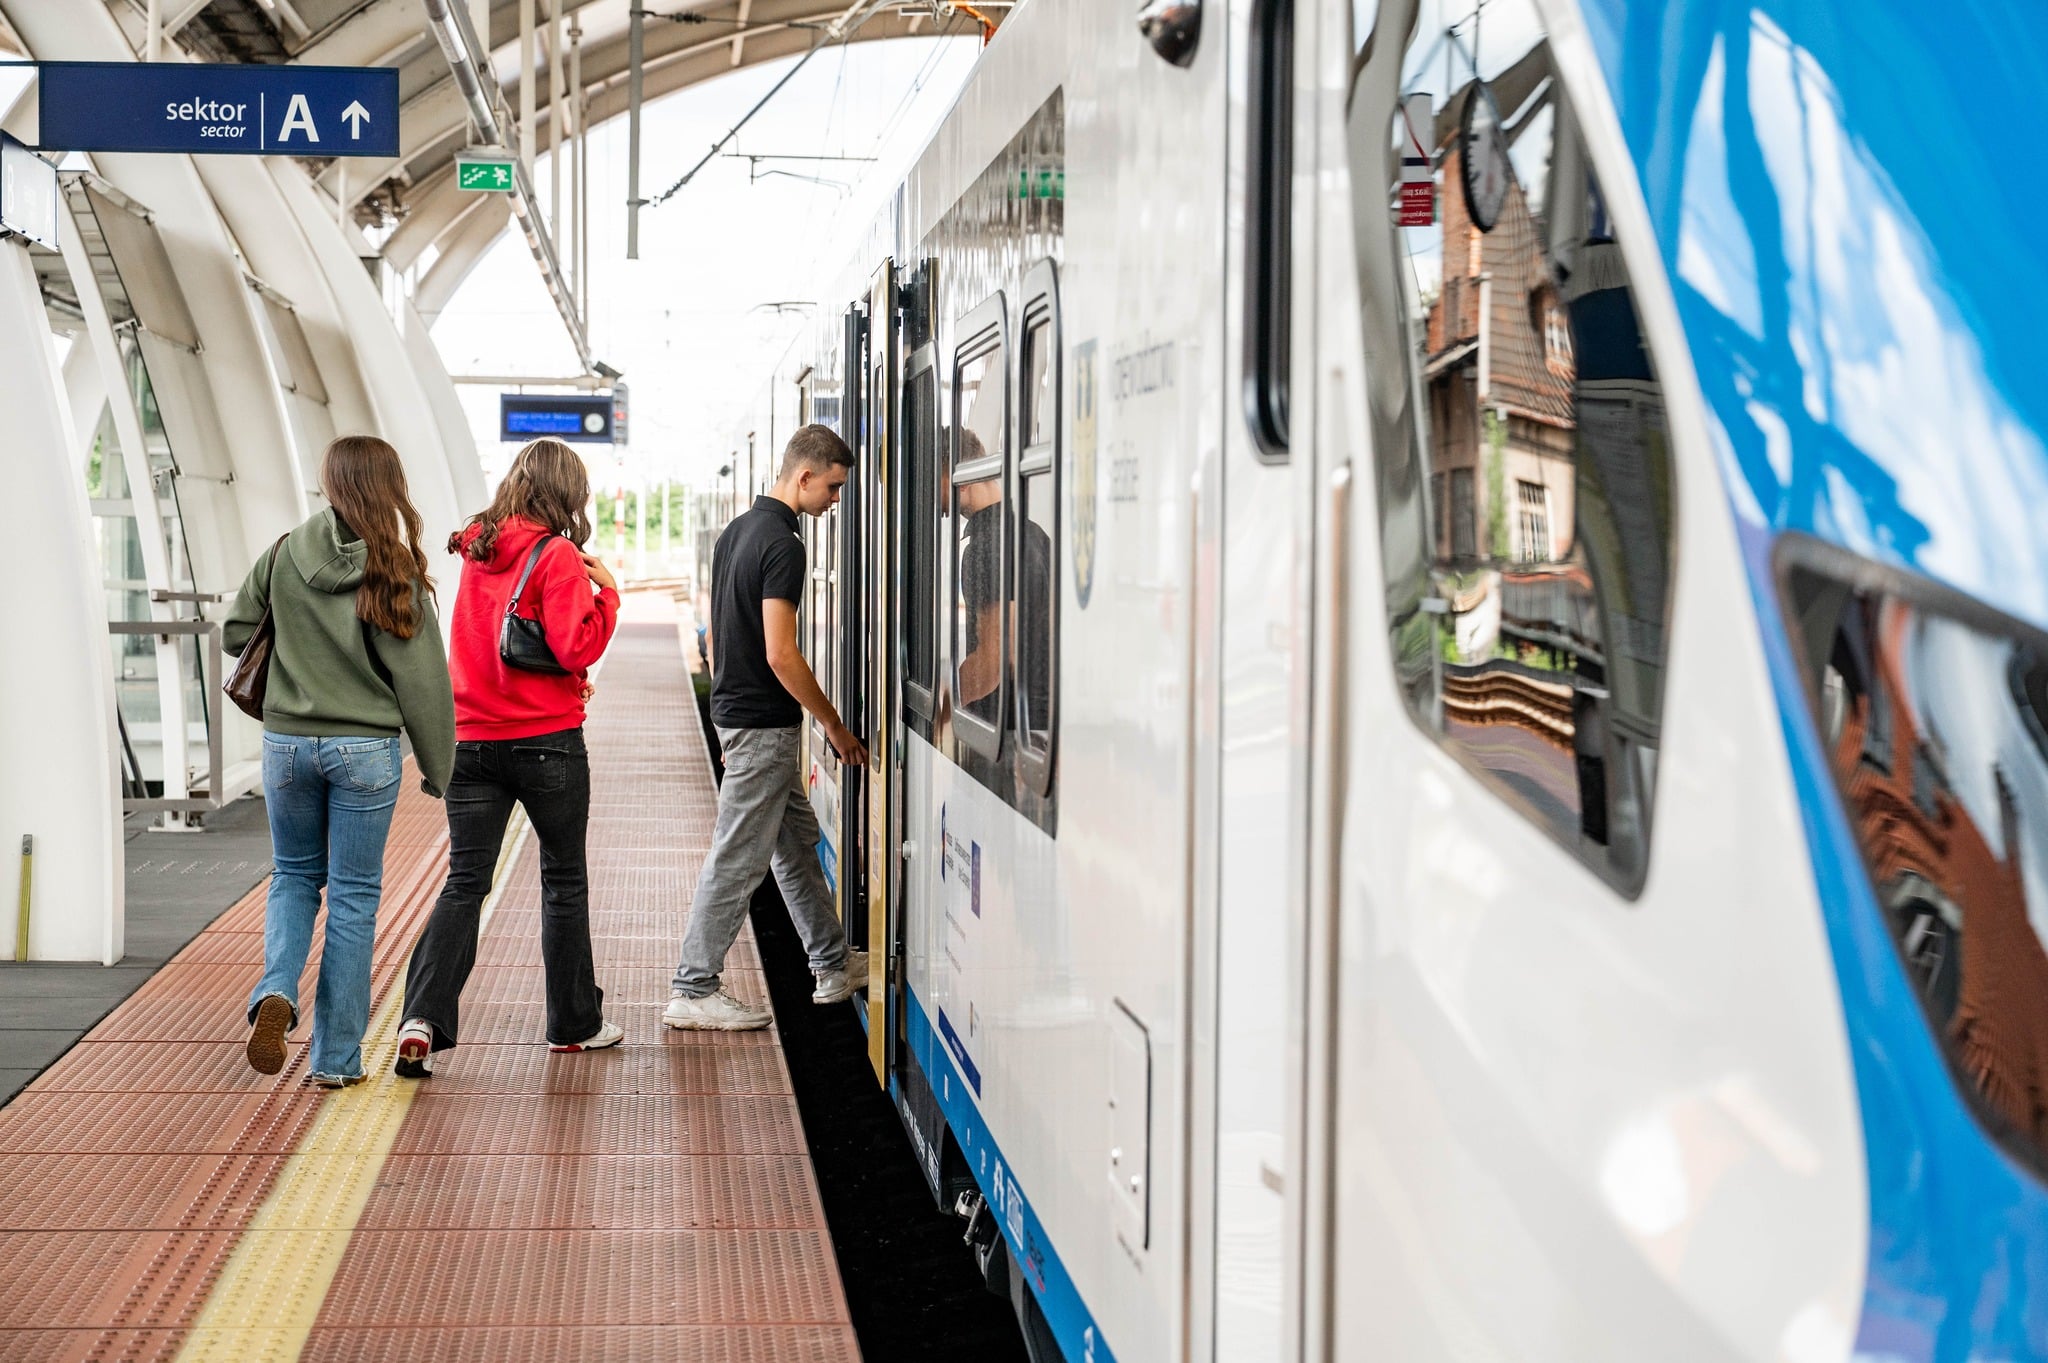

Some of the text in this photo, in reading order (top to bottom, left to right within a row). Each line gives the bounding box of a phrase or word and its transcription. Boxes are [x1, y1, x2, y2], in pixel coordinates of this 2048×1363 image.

[166, 97, 246, 121] sektor
[278, 94, 320, 142] A
[200, 125, 246, 137] sector
